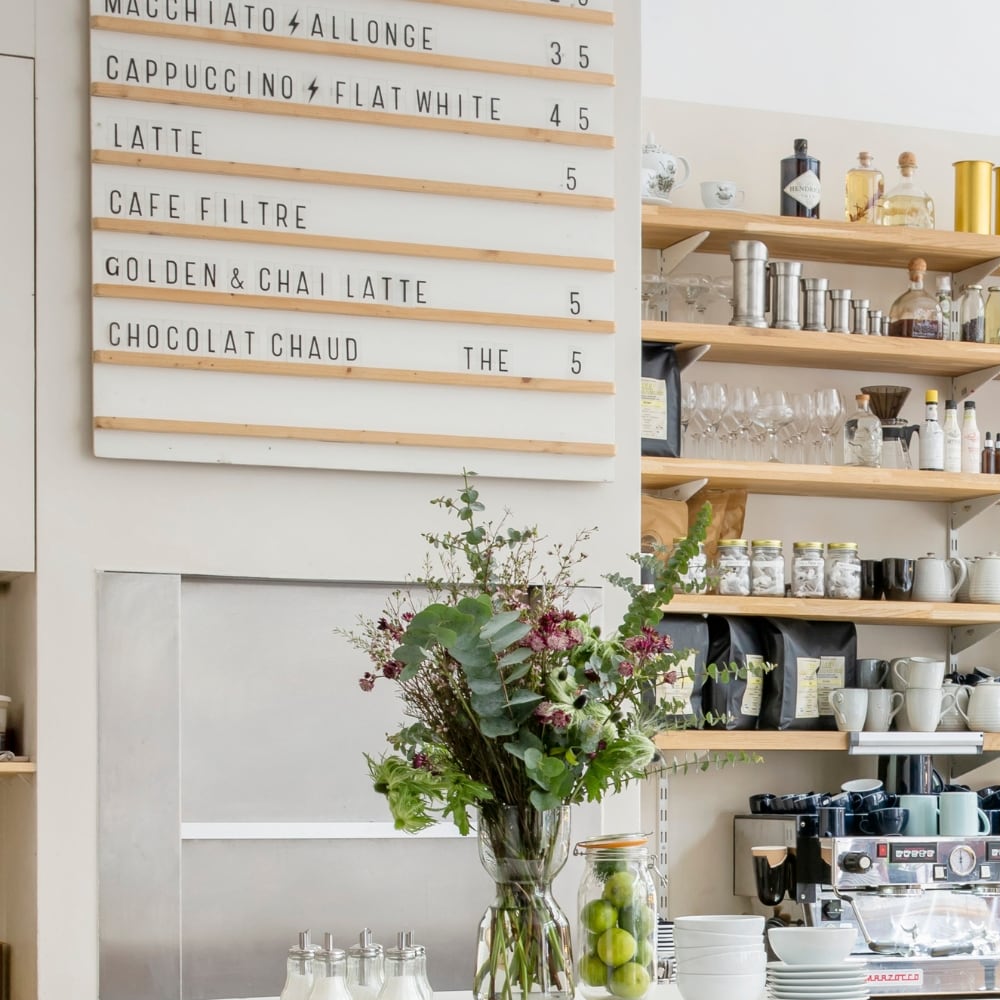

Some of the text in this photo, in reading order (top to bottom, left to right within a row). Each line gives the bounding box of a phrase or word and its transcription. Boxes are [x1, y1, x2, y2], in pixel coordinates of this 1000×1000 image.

[104, 0, 275, 32] MACCHIATO
[310, 13, 433, 51] ALLONGE
[106, 54, 293, 100] CAPPUCCINO
[335, 80, 402, 111] FLAT
[416, 88, 501, 121] WHITE
[114, 122, 577, 191] LATTE 5
[109, 189, 307, 230] CAFE FILTRE
[105, 256, 581, 316] GOLDEN & CHAI LATTE 5
[108, 321, 582, 376] CHOCOLAT CHAUD THE 5
